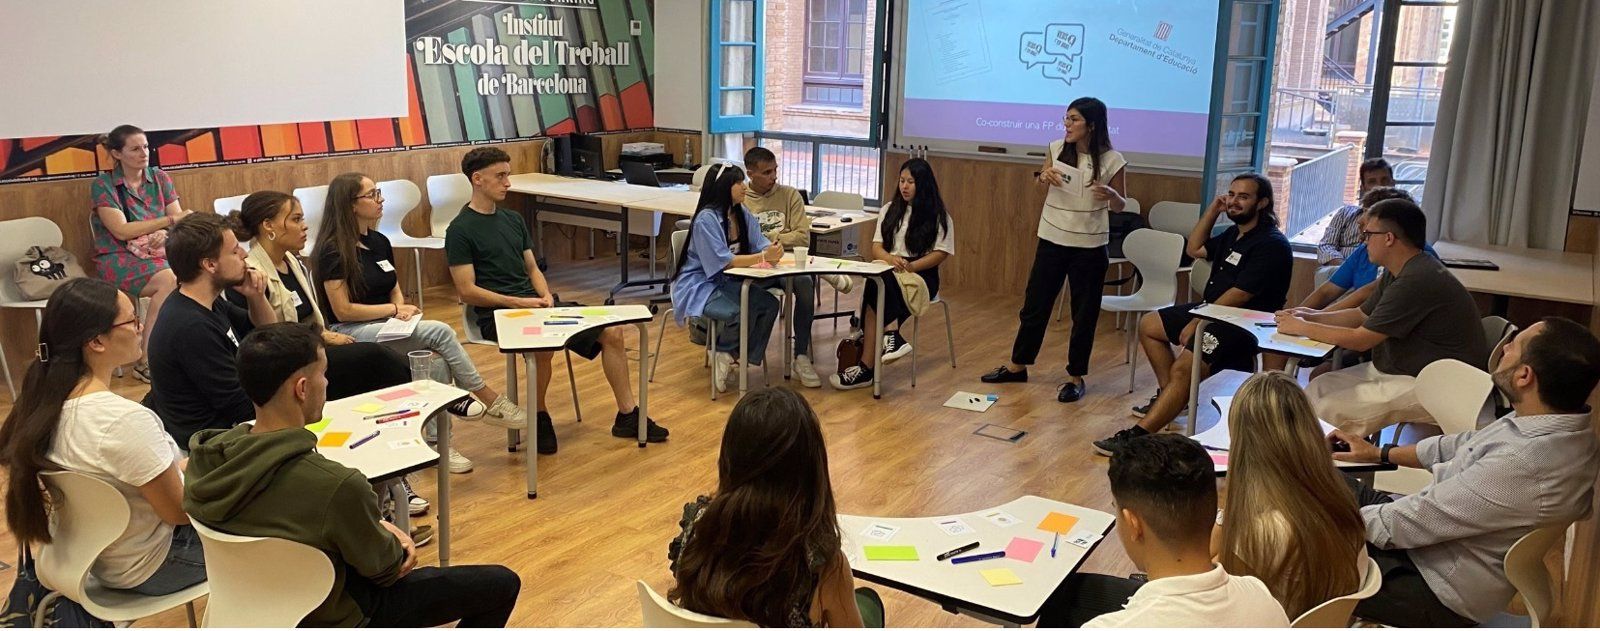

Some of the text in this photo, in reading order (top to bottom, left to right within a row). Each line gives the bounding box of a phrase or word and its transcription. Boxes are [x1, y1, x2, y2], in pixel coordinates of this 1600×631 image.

[503, 13, 564, 36] Institut
[417, 37, 630, 66] Escola del Treball
[1108, 33, 1198, 75] Departament d'Educació
[1116, 28, 1152, 47] Generalitat
[1162, 46, 1197, 66] Catalunya
[478, 72, 587, 96] de Barcelona
[975, 117, 1023, 129] Co-construir
[1025, 121, 1040, 129] una
[1042, 121, 1054, 130] FP
